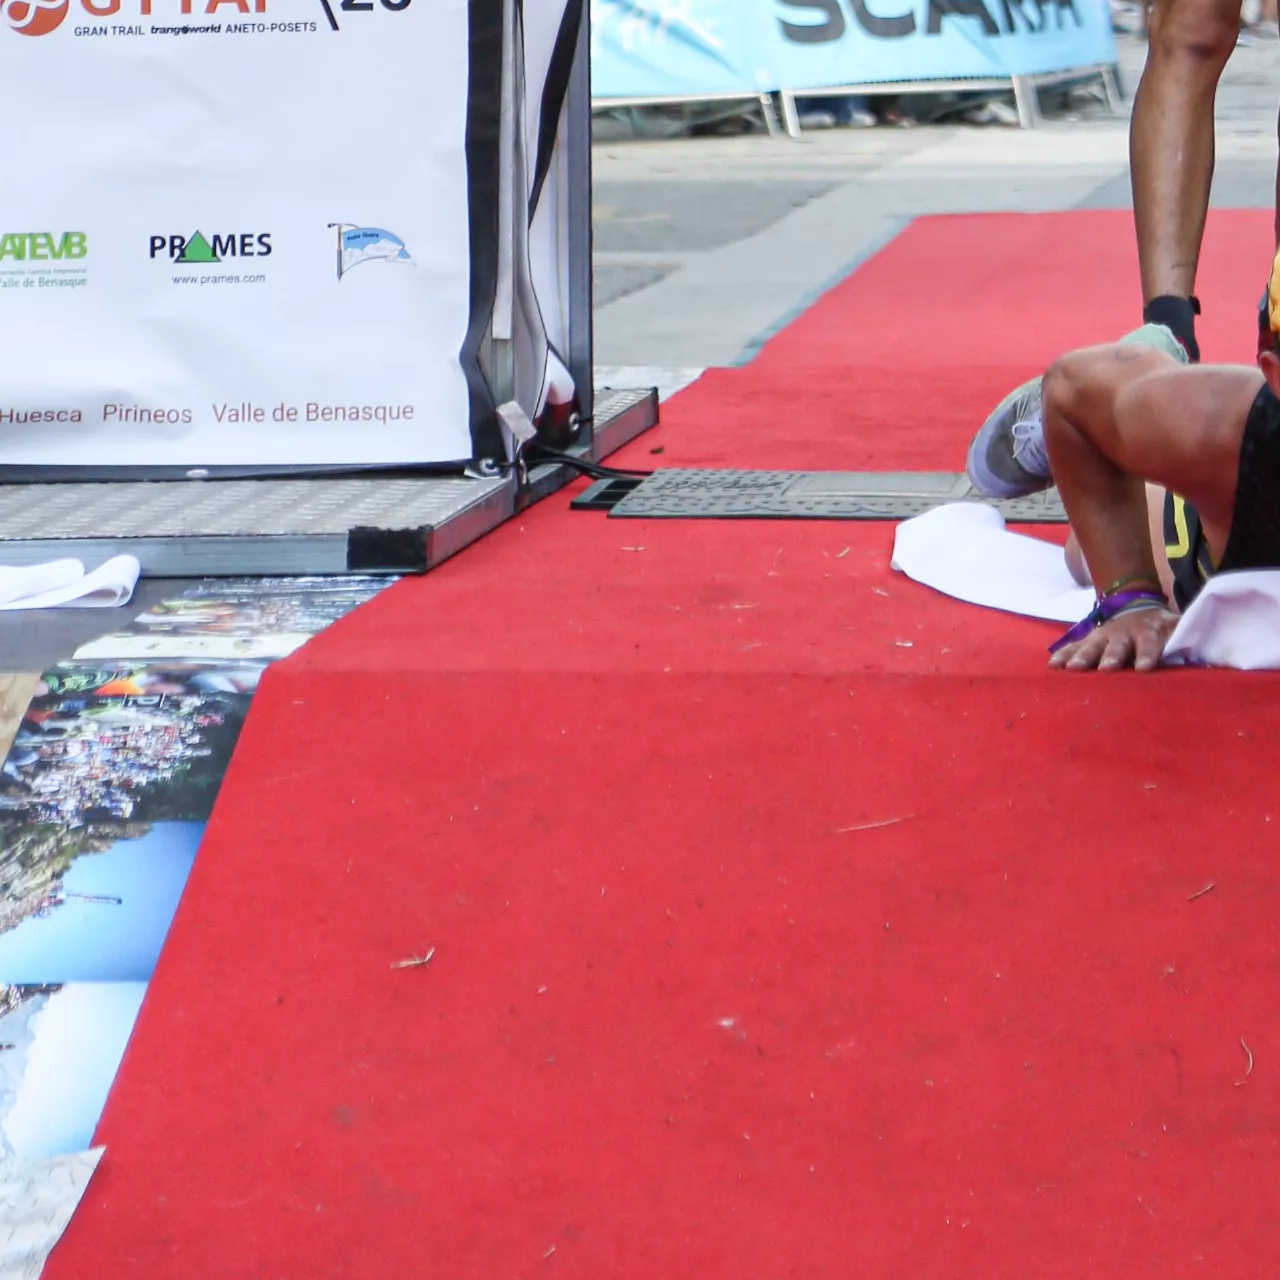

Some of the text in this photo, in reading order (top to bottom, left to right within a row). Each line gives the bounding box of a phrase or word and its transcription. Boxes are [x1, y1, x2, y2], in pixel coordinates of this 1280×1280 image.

[74, 25, 108, 37] GRAN
[112, 24, 145, 36] TRAIL
[225, 22, 317, 35] ANETO-POSETS
[23, 276, 34, 288] de
[38, 276, 87, 289] Benasque
[171, 274, 267, 286] www.prames.com
[0, 402, 415, 426] Huesca Pirineos Valle de Benasque
